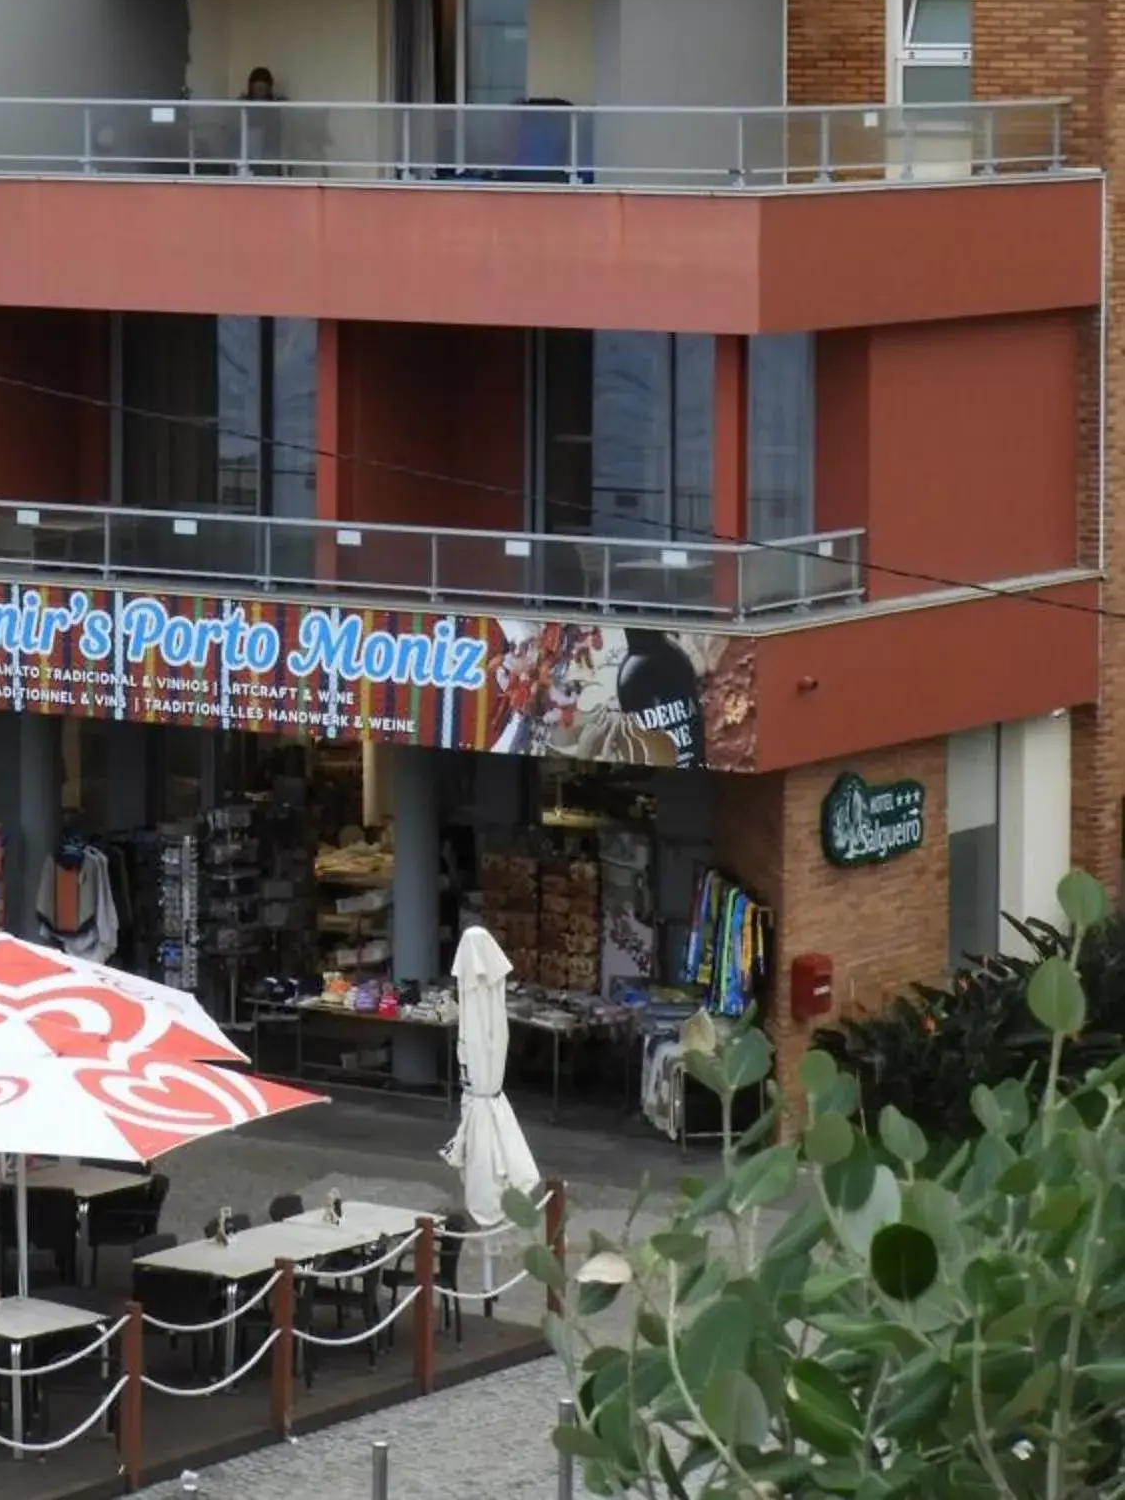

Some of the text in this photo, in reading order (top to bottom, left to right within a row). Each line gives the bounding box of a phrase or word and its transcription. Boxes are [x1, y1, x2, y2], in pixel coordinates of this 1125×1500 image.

[123, 598, 281, 674] Porto
[286, 608, 488, 691] Moniz
[46, 666, 138, 688] TRADICIONAL
[142, 675, 152, 688] &
[156, 677, 209, 693] VINHOS
[222, 682, 298, 700] ARTCRAFT
[302, 688, 312, 700] &
[80, 695, 90, 705] &
[145, 698, 264, 720] TRADITIONELLES
[268, 709, 350, 727] HANDWERK
[354, 716, 364, 729] &
[368, 717, 416, 733] WEINE
